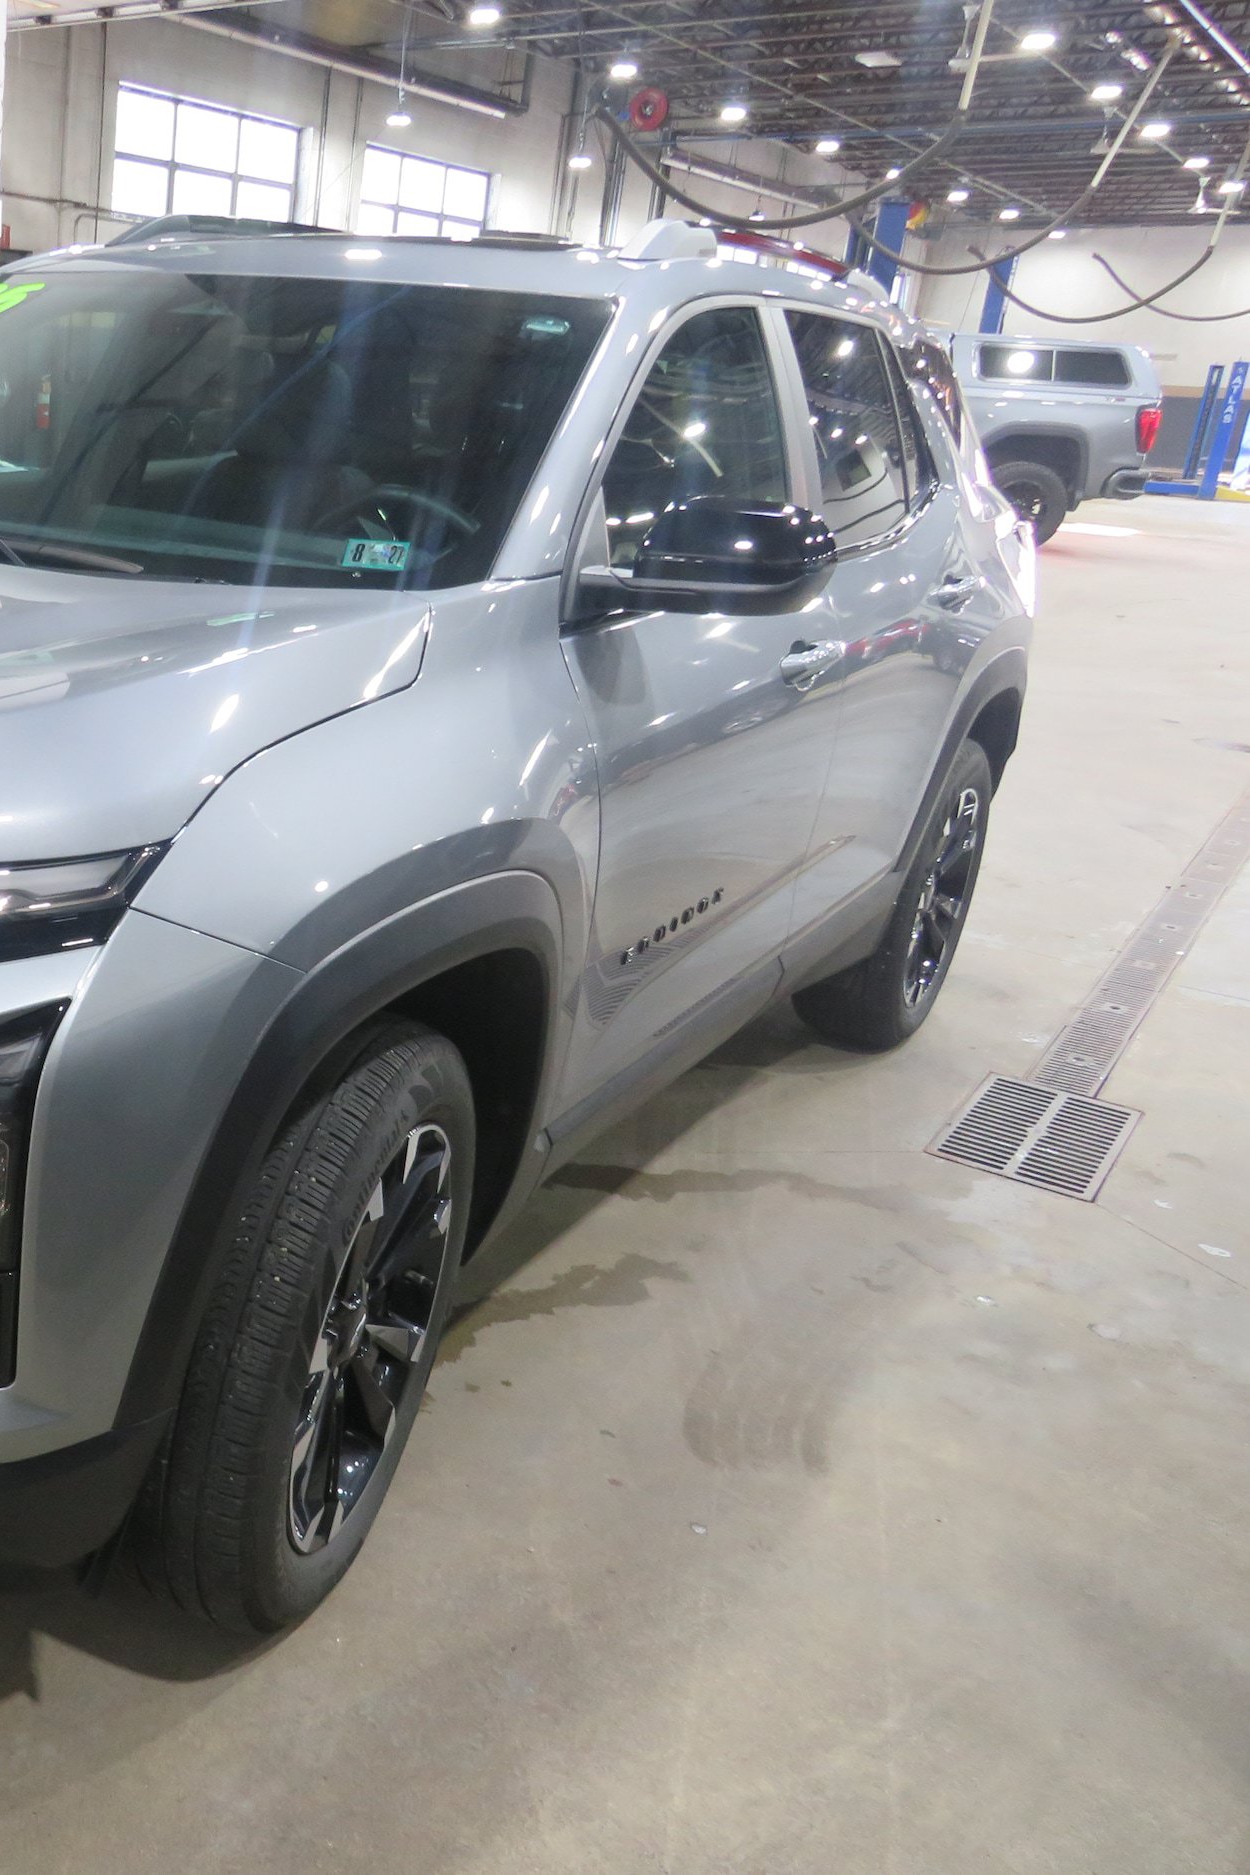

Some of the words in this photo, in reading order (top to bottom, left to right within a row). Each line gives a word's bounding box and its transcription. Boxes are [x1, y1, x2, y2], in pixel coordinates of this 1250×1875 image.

[1222, 375, 1242, 424] ATLAS
[351, 543, 366, 562] 8
[387, 545, 405, 565] 27
[620, 887, 724, 966] EQUINOX
